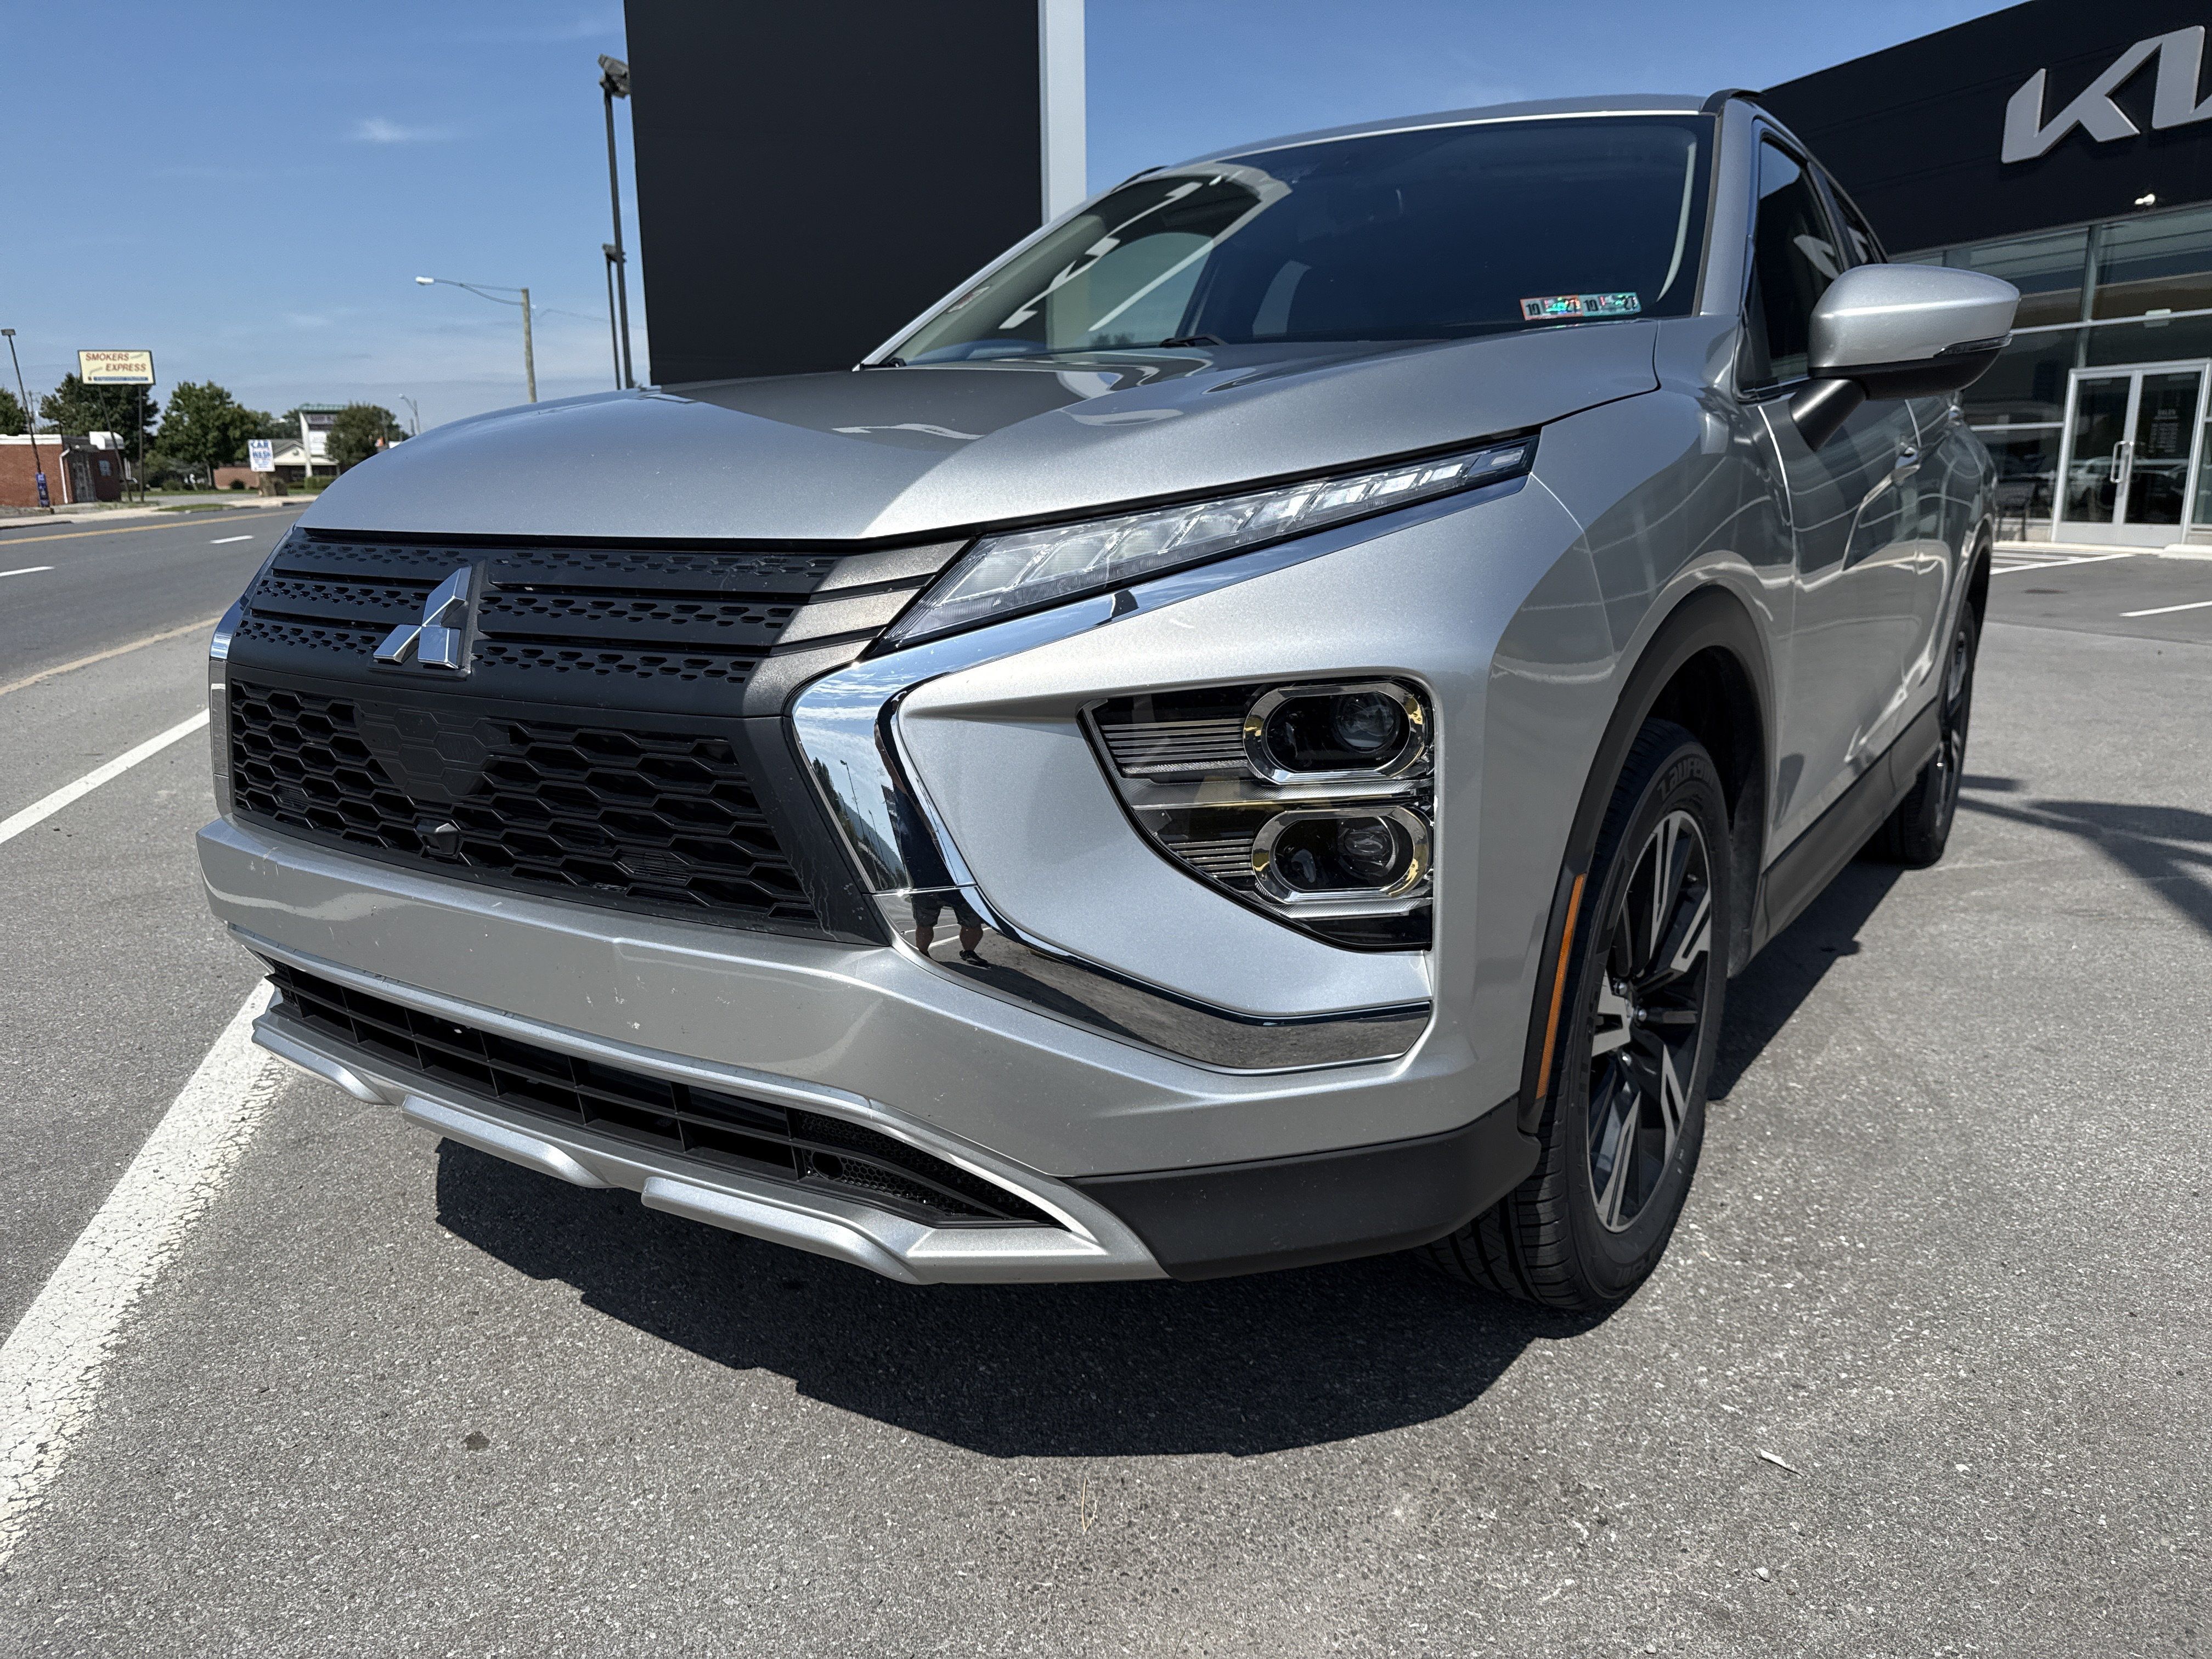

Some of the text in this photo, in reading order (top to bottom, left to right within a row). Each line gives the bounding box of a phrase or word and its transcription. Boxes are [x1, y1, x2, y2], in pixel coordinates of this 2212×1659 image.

[2001, 25, 2212, 164] KI
[86, 353, 129, 361] SMOKERS
[106, 363, 146, 371] EXPRESS
